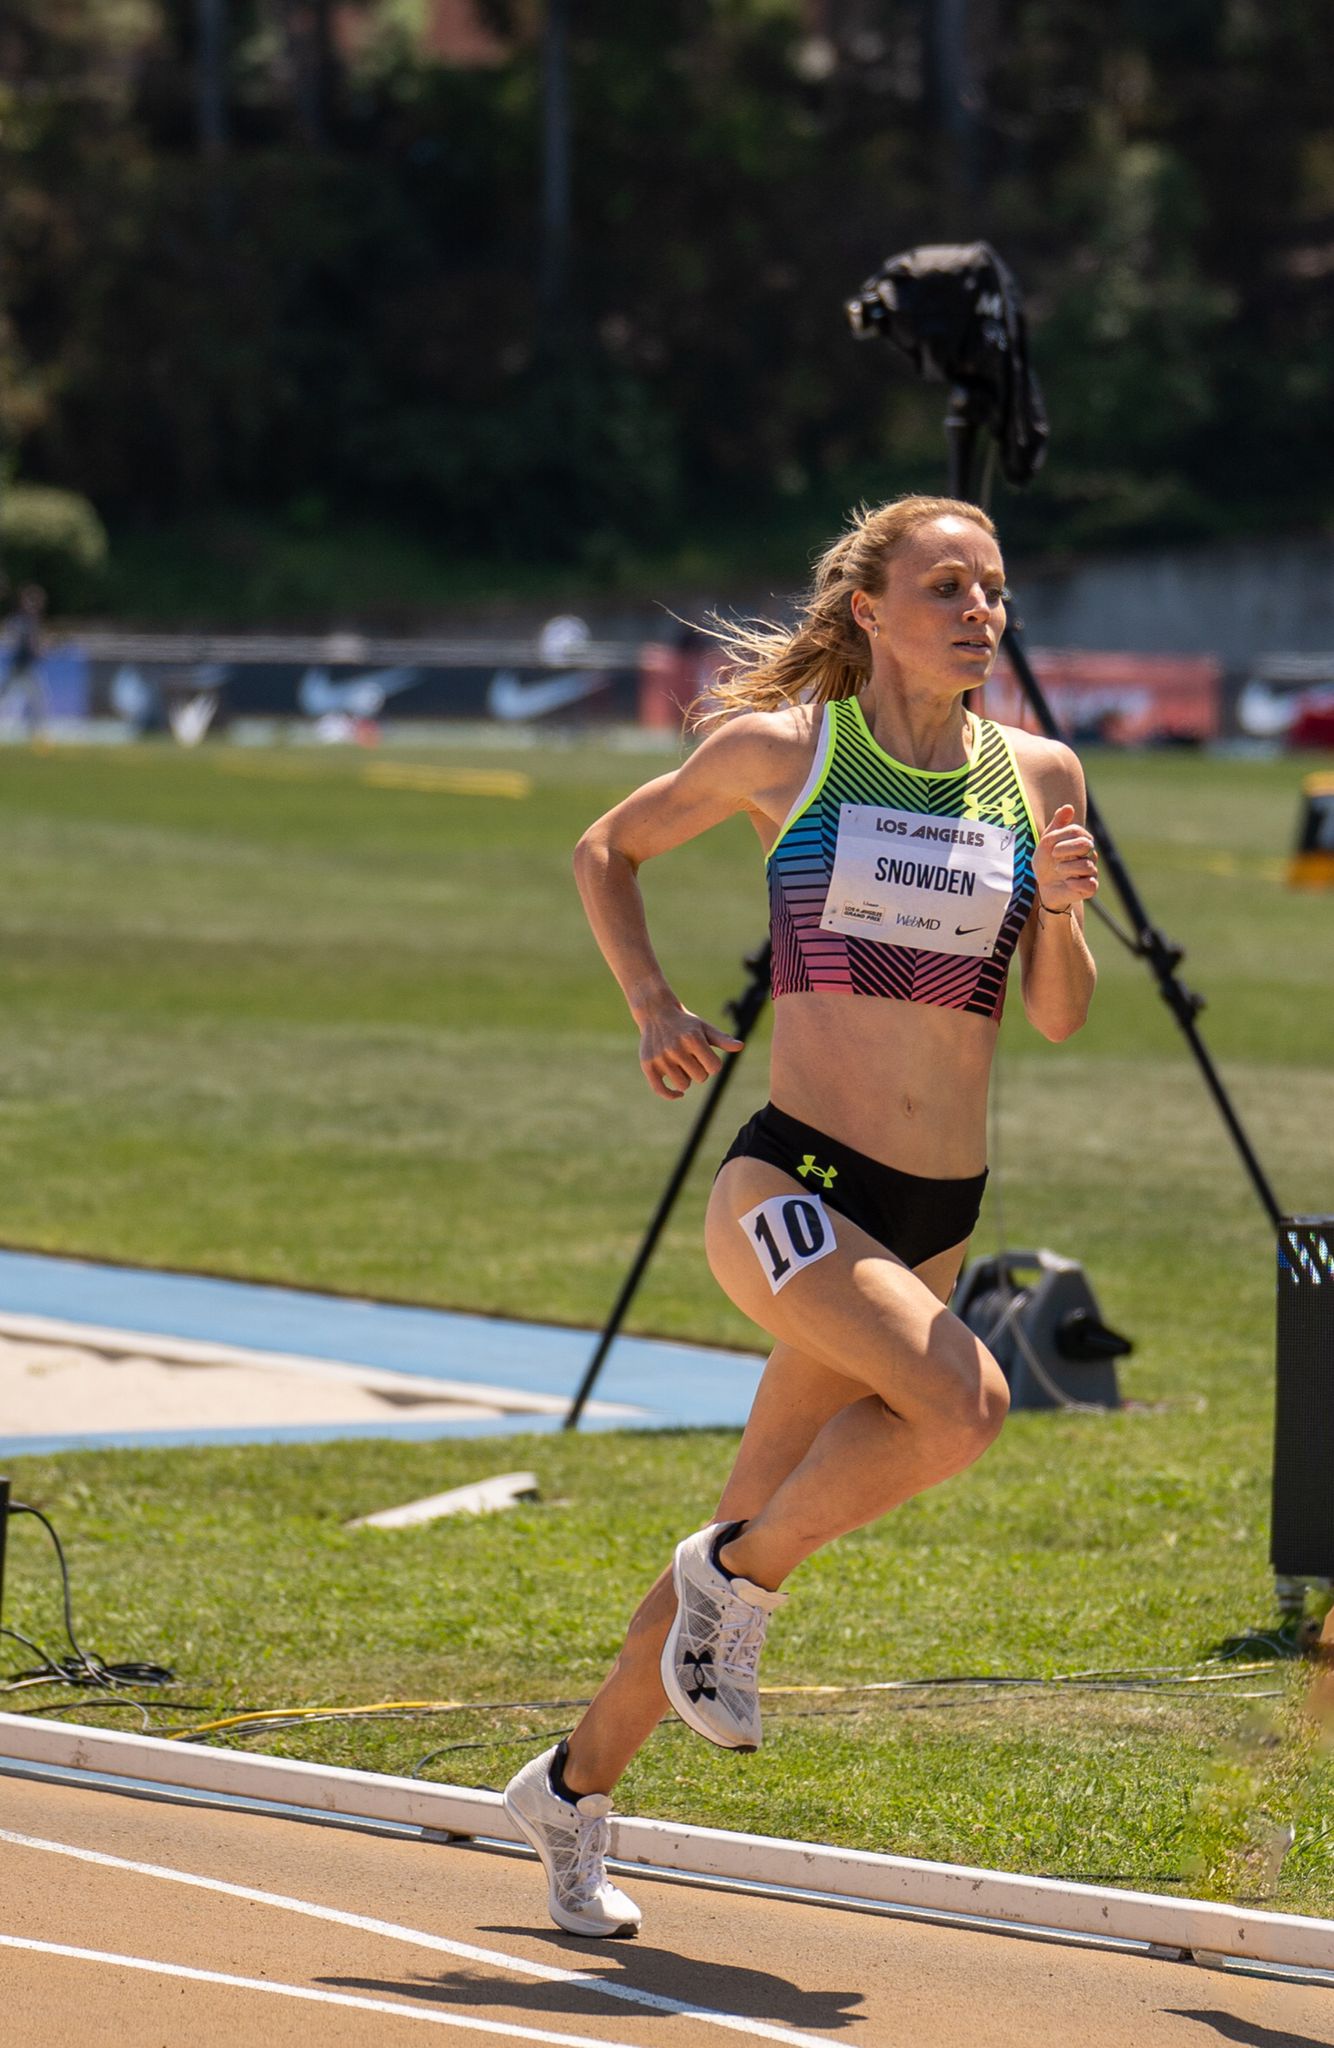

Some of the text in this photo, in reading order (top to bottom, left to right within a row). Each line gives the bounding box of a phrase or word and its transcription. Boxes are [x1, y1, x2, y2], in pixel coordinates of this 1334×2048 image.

[876, 818, 985, 847] LOS ANGELES
[875, 857, 976, 897] SNOWDEN
[896, 913, 941, 931] WebMD
[754, 1199, 825, 1282] 10
